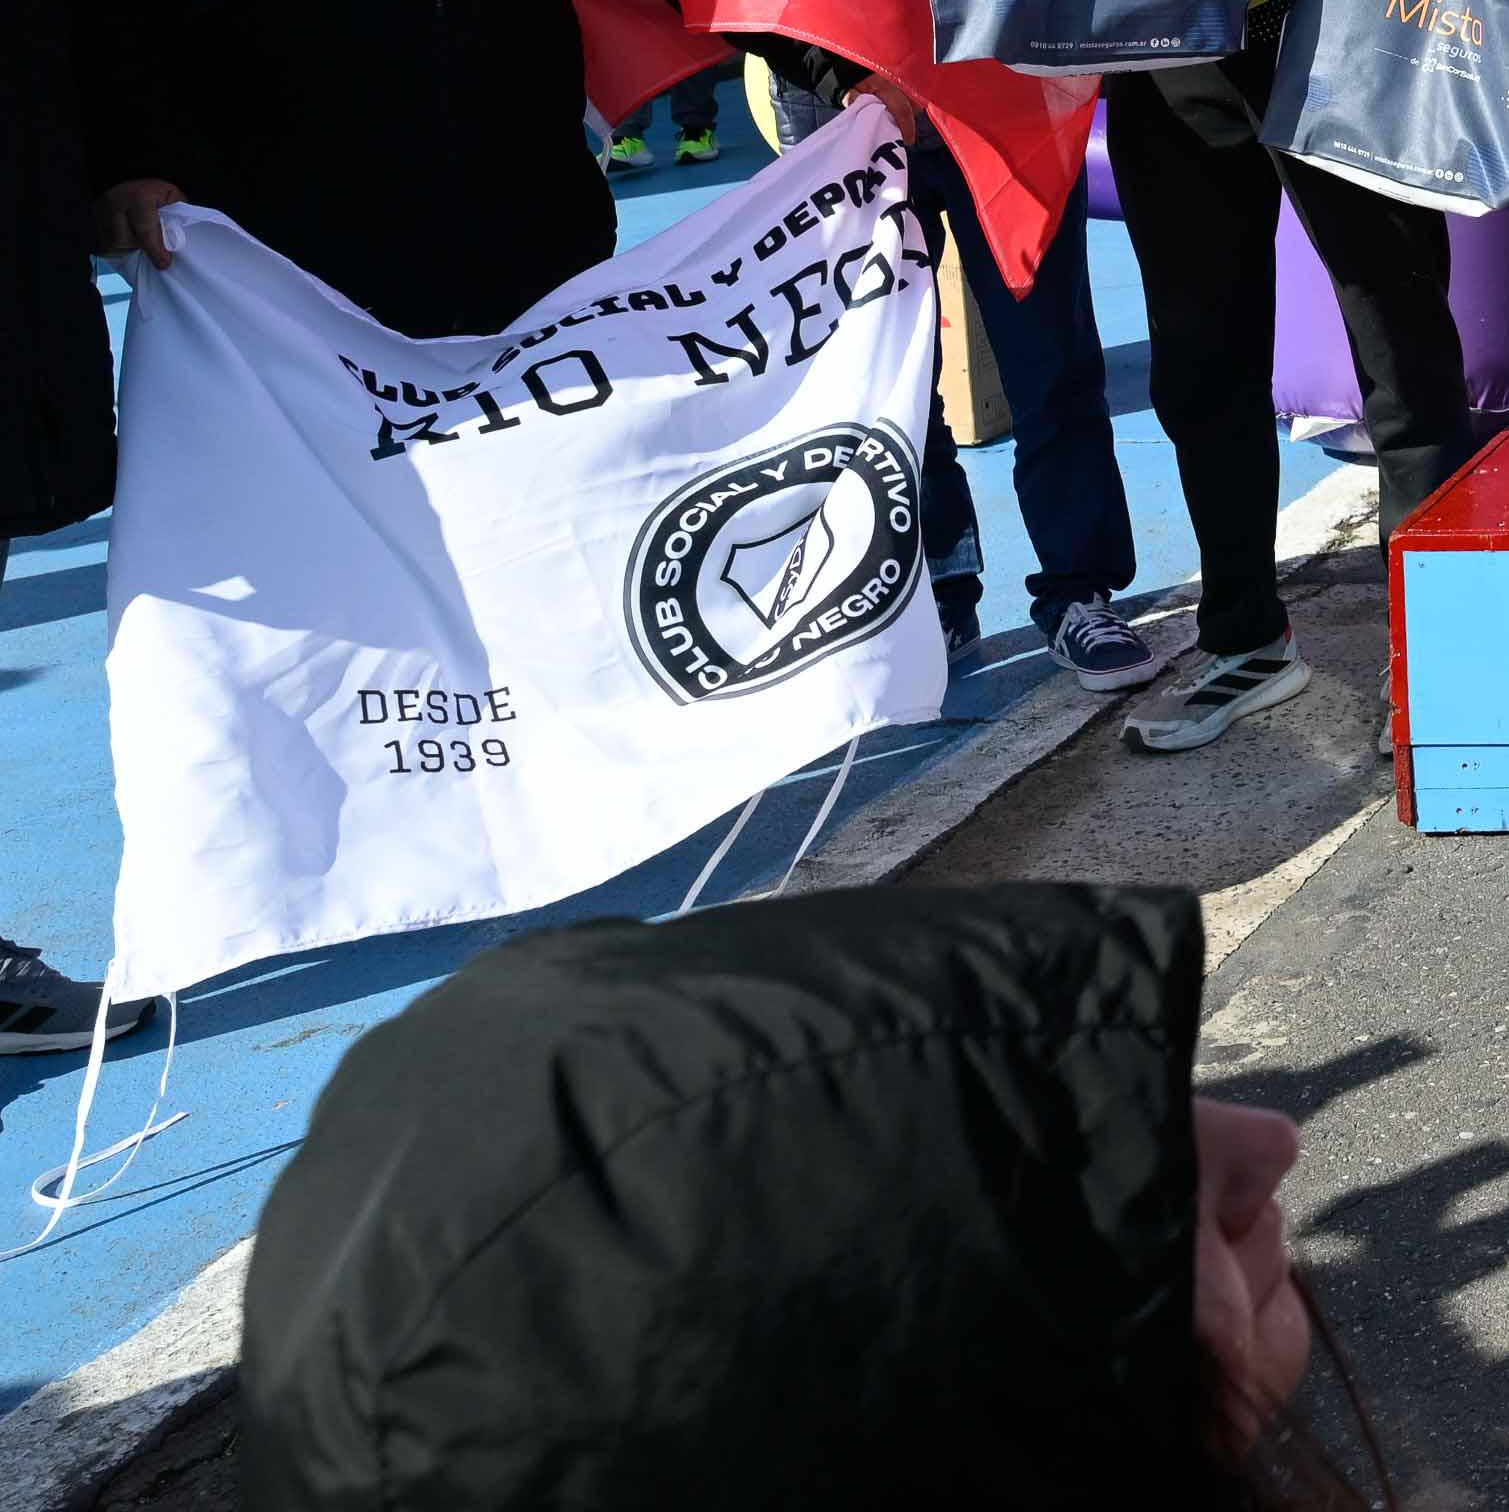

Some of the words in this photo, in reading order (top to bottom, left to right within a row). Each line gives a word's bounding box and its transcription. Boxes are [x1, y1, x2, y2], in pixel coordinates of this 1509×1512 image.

[710, 257, 743, 287] Y
[760, 459, 789, 482] Y
[655, 480, 759, 587] SOCIAL
[791, 557, 900, 651] NEGRO
[655, 597, 728, 690] CLUB
[357, 686, 517, 726] DESDE
[384, 738, 511, 774] 1939
